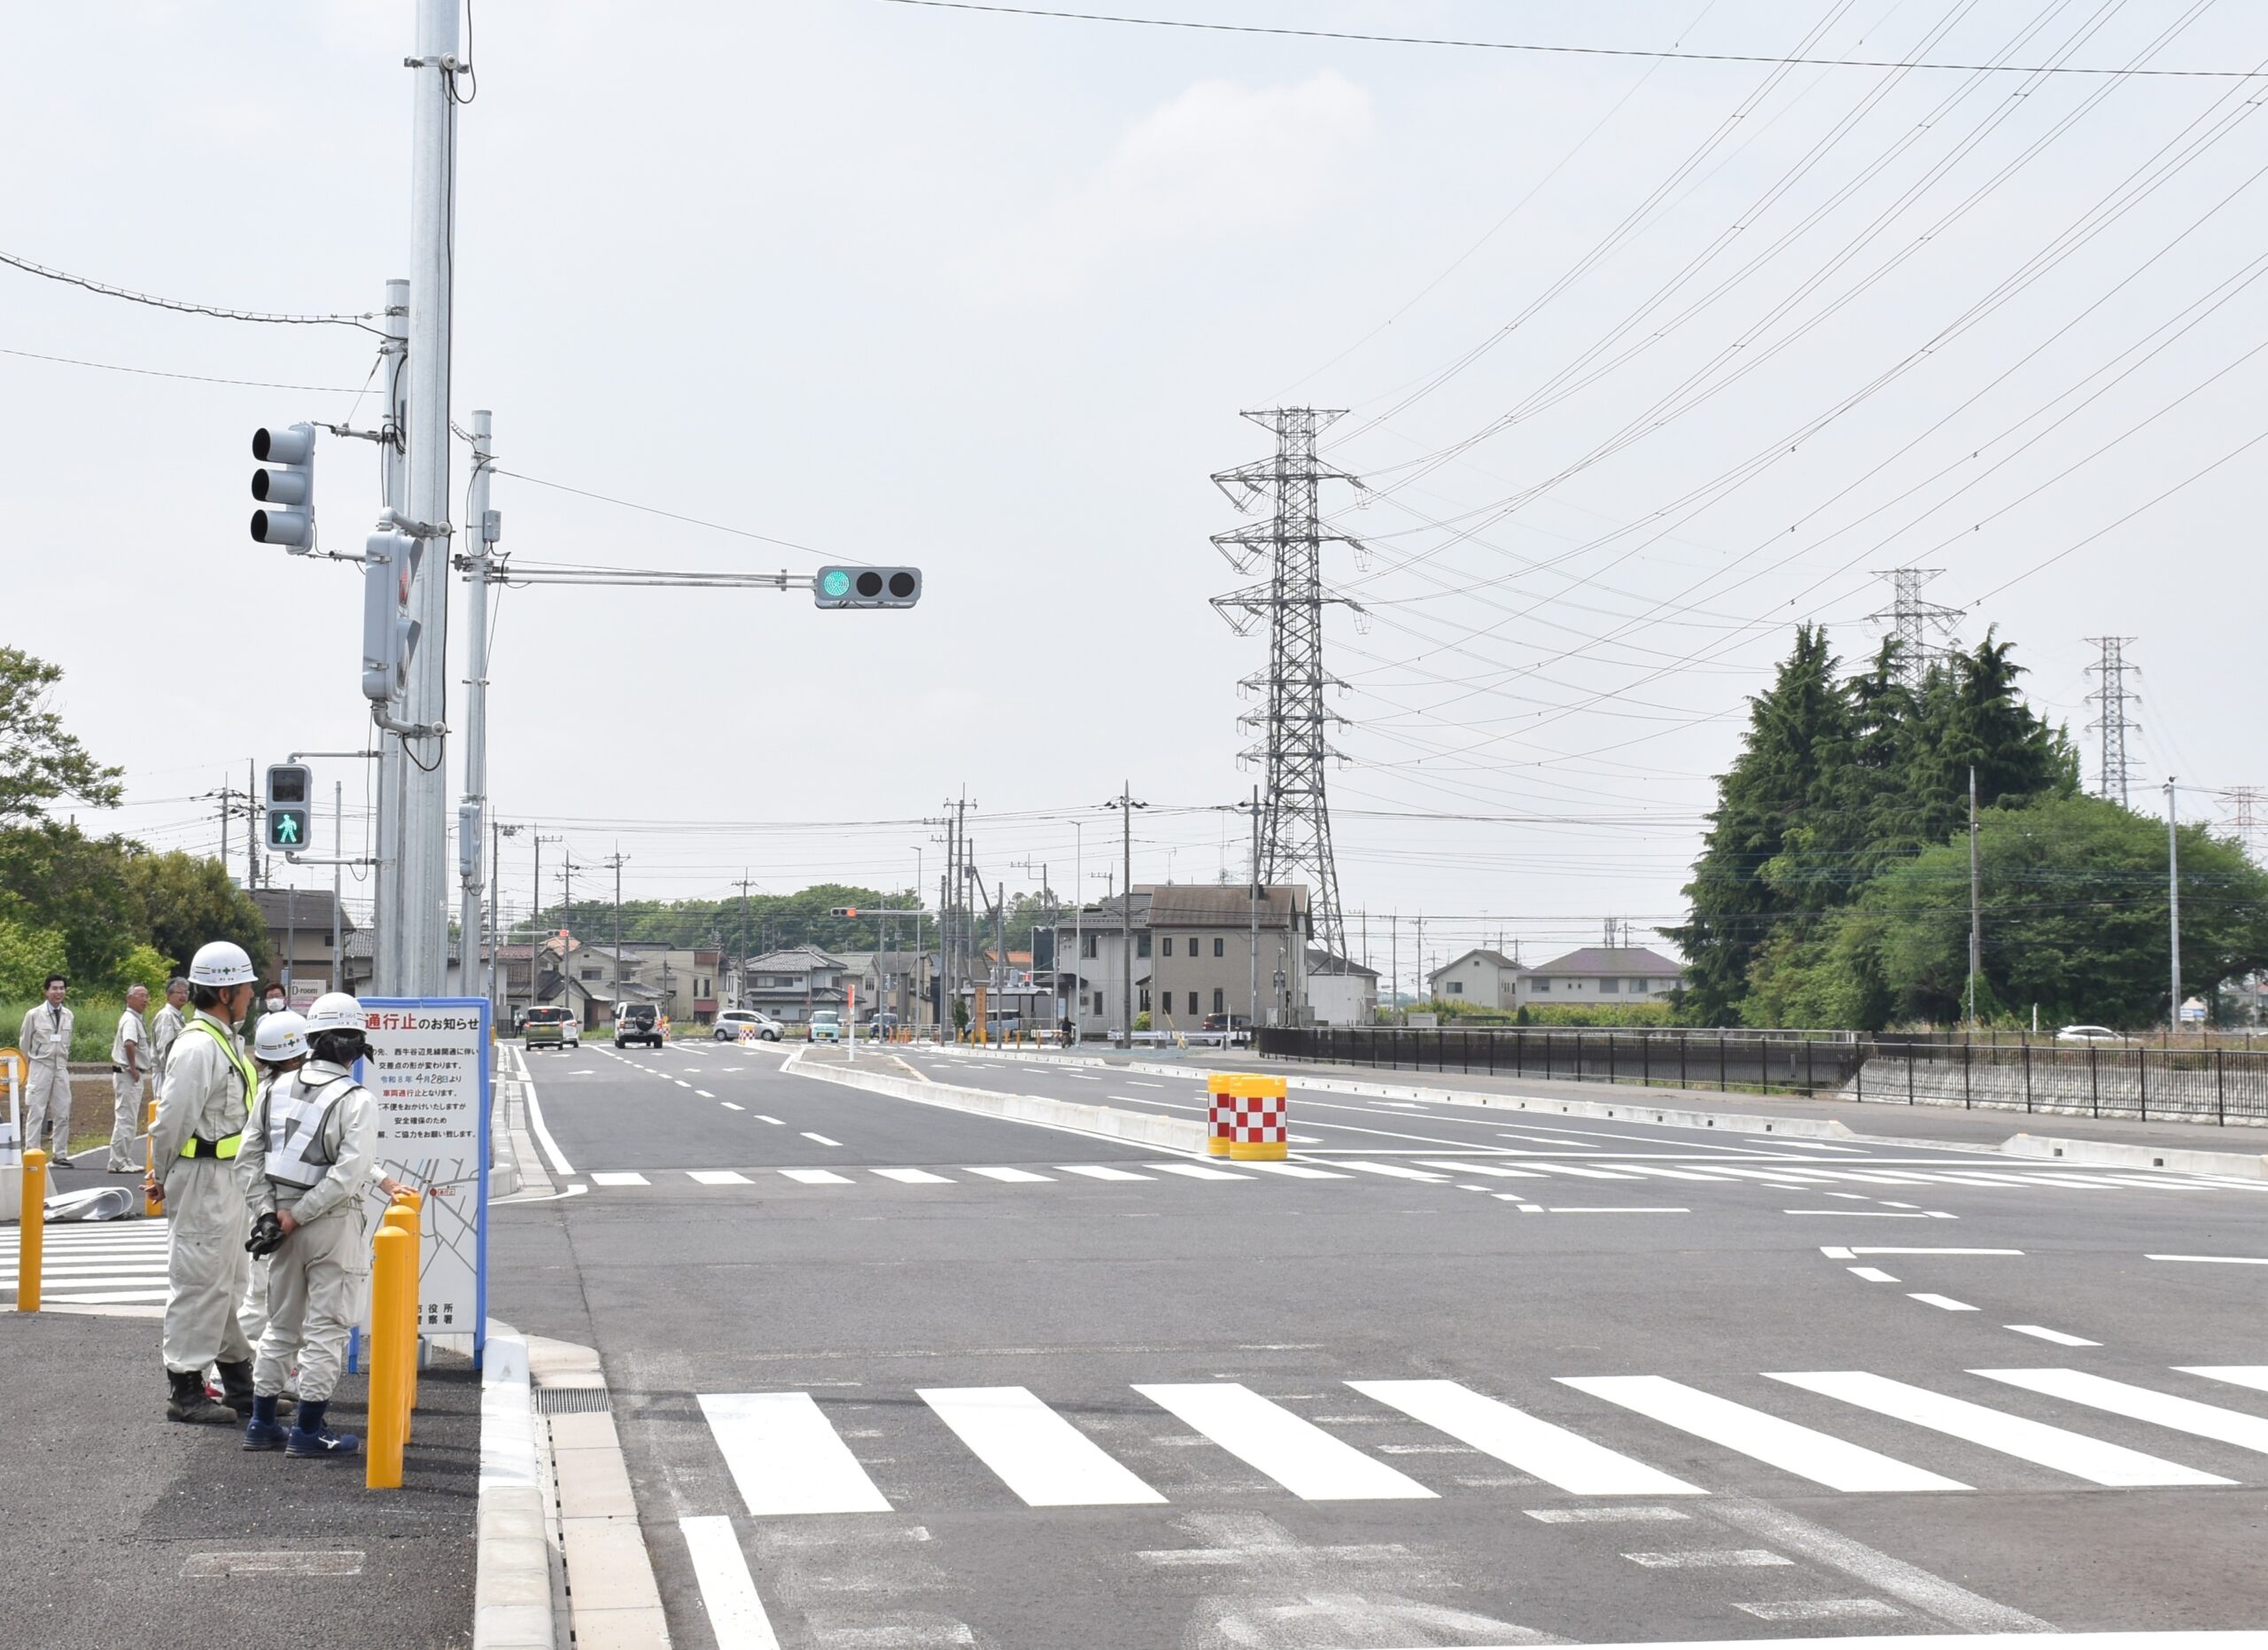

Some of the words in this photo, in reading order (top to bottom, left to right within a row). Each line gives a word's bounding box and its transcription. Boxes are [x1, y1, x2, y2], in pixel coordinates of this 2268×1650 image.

[365, 1013, 479, 1030] 通行止のお知らせ
